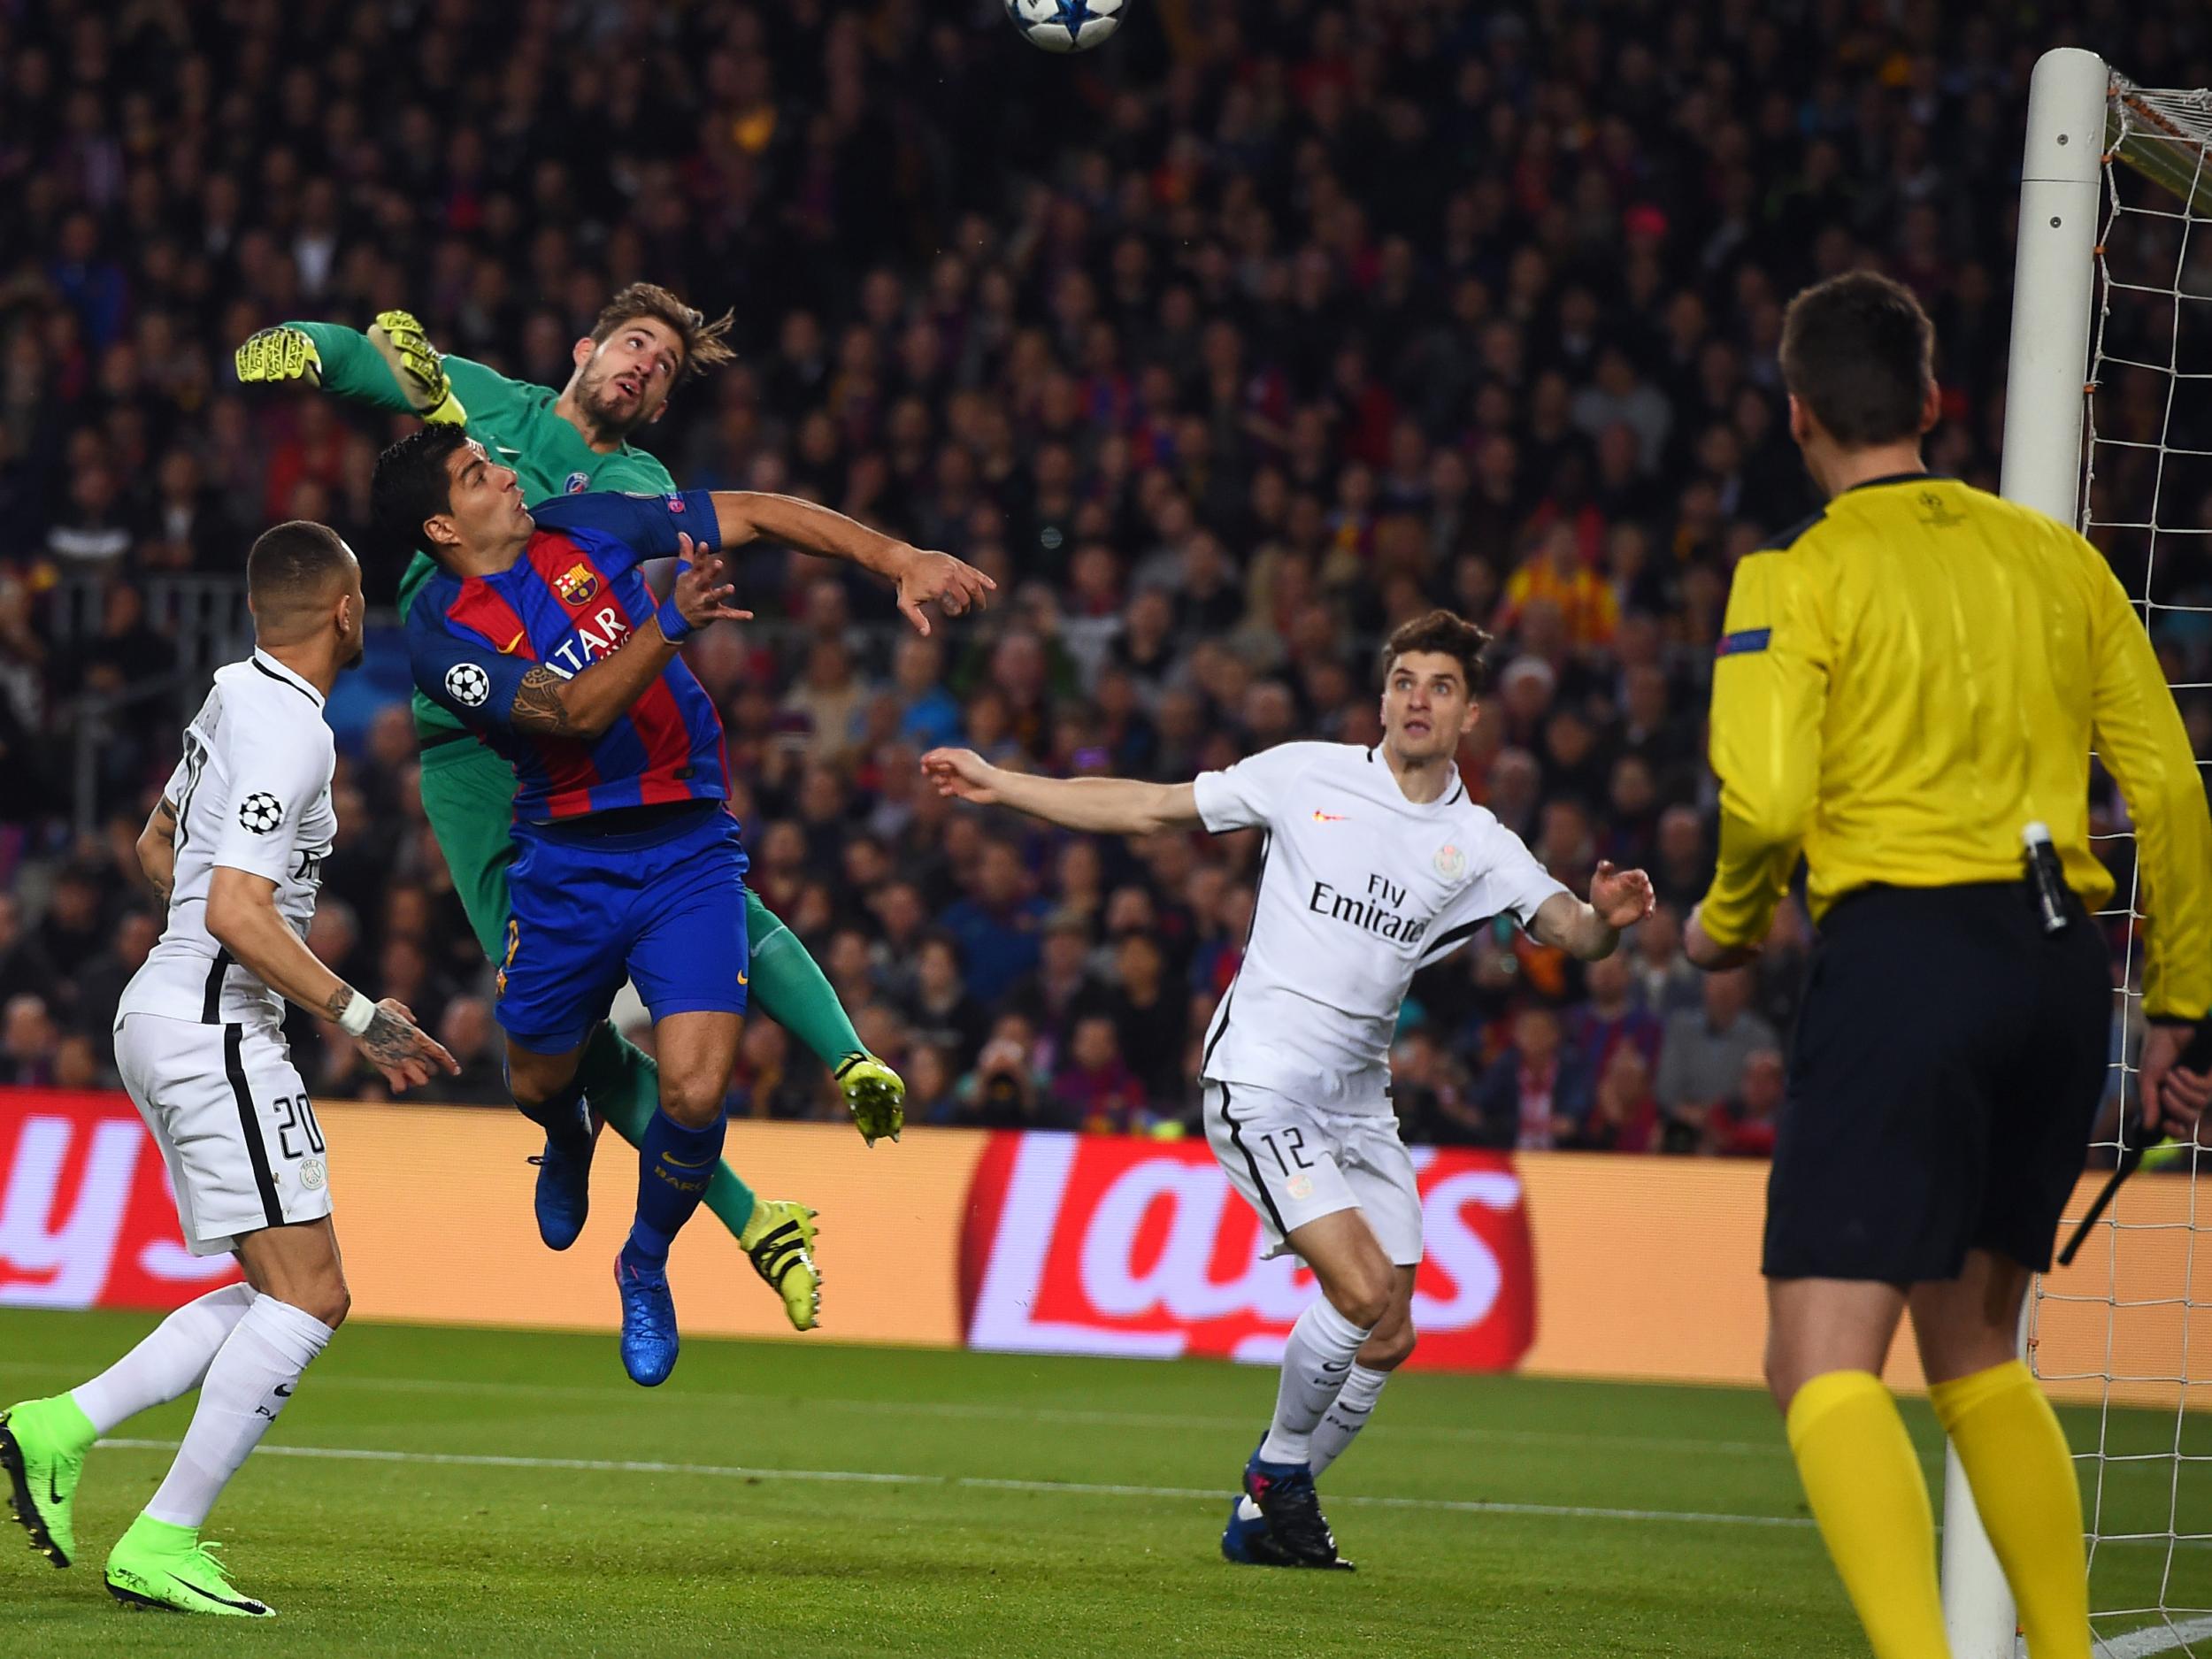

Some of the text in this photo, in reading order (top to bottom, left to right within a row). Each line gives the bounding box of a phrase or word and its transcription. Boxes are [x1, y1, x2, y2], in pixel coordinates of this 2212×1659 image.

[1310, 881, 1428, 943] Emirate
[1367, 873, 1407, 909] Fly
[273, 1093, 326, 1160] 20
[1259, 1126, 1315, 1178] 12
